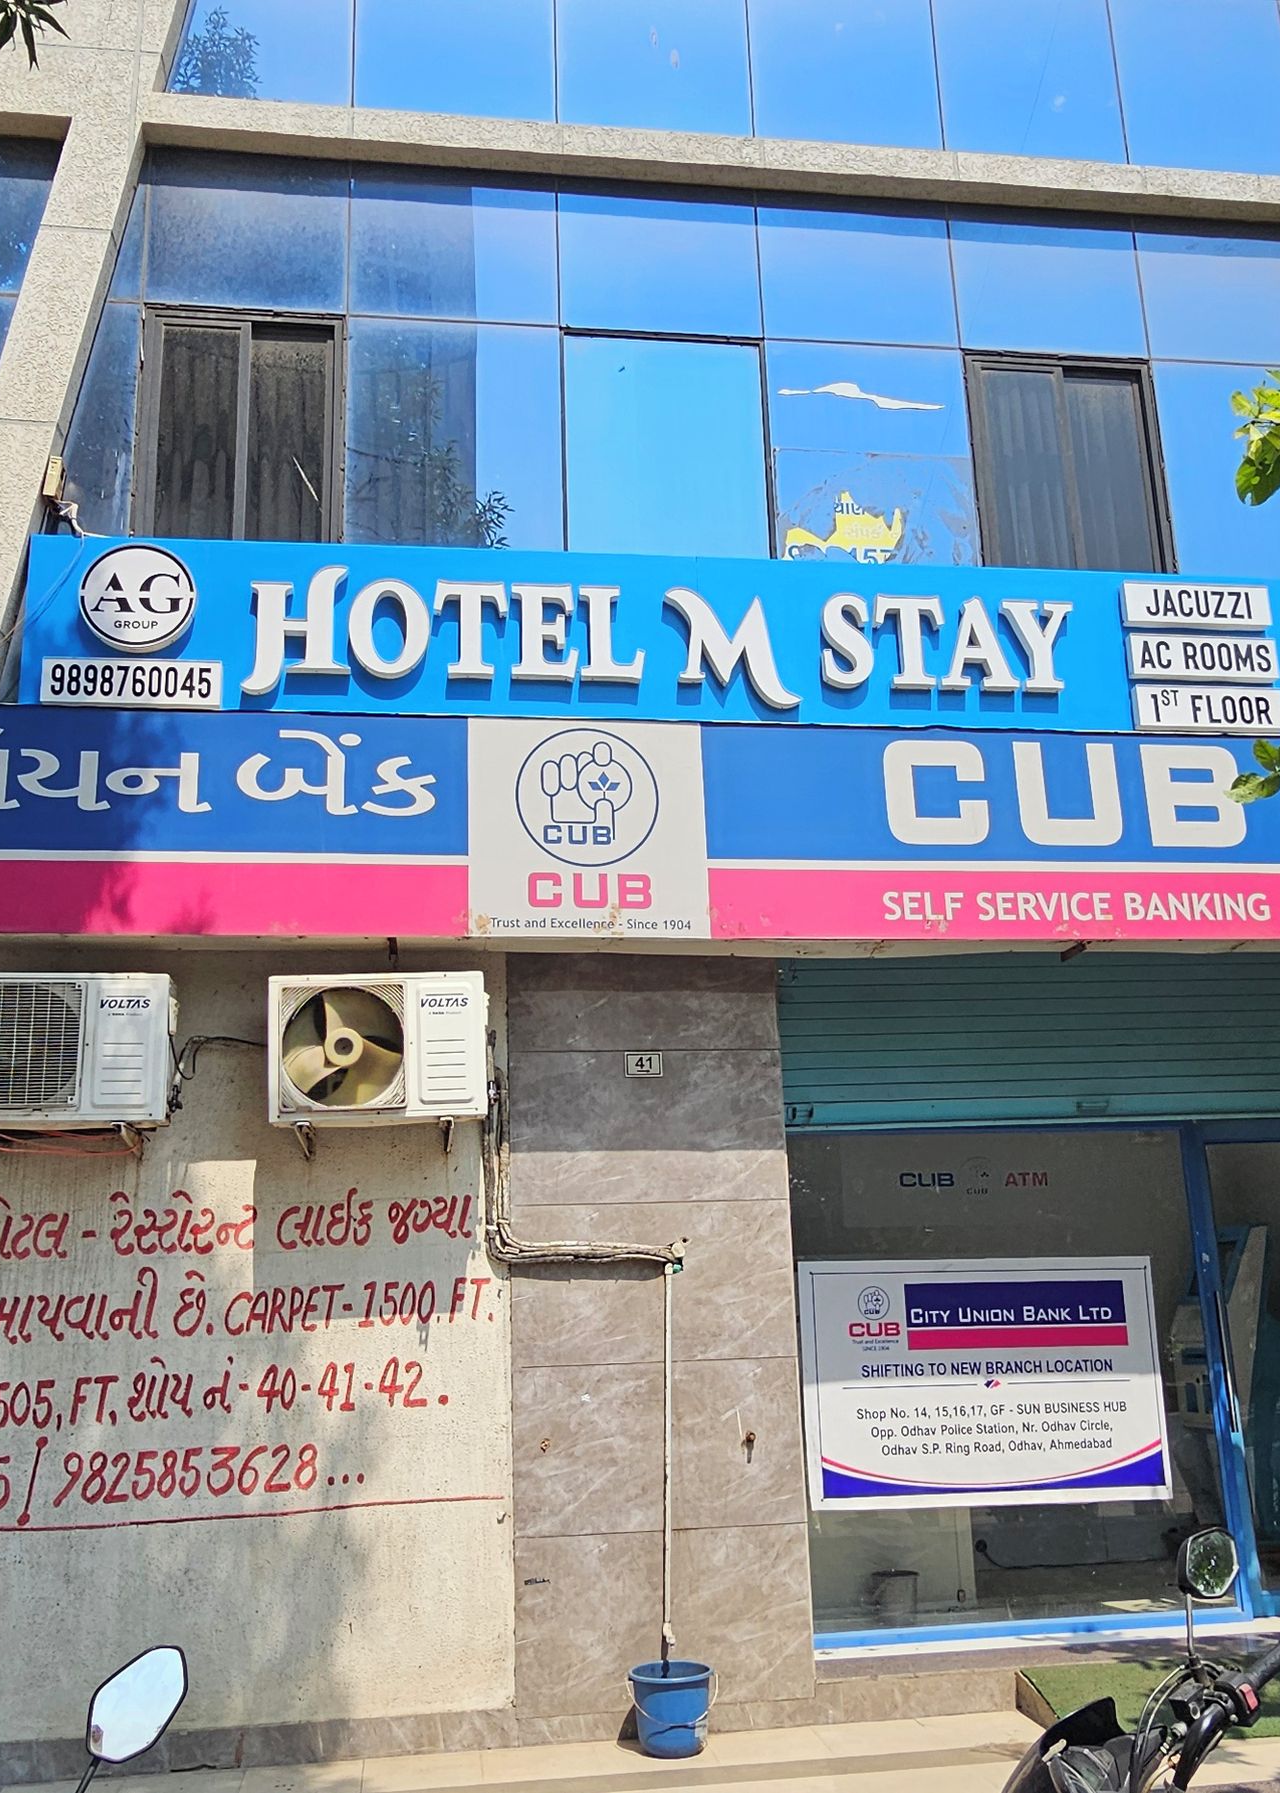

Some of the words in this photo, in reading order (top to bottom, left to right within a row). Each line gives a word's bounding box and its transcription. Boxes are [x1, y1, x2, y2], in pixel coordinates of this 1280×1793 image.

[90, 572, 184, 614] AG
[1145, 588, 1253, 620] JACUZZI
[114, 620, 158, 629] GROUP
[240, 565, 645, 696] HOTEL
[663, 586, 802, 711] M
[821, 592, 1073, 694] STAY
[1140, 640, 1172, 670] AC
[1181, 641, 1272, 673] ROOMS
[49, 663, 212, 699] 9898760045
[1150, 688, 1179, 723] 1ST
[1190, 694, 1273, 725] FLOOR
[236, 729, 436, 817] બેંક
[882, 740, 1248, 849] CUB
[543, 824, 612, 845] CUB
[527, 872, 652, 910] CUB
[882, 891, 965, 922] SELF
[976, 892, 1111, 923] SERVICE
[1124, 892, 1271, 923] BANKING
[490, 917, 521, 929] Trust
[524, 918, 547, 929] and
[550, 918, 615, 929] Excellence
[626, 918, 658, 930] Since
[663, 919, 692, 930] 1904
[100, 998, 151, 1009] VOLTAS
[420, 997, 469, 1008] VOLTAS
[634, 1056, 653, 1070] 41
[899, 1172, 955, 1188] CUB
[1005, 1171, 1048, 1187] ATM
[848, 1322, 901, 1337] CUB
[861, 1363, 925, 1378] SHIFTING
[928, 1362, 947, 1376] TO
[951, 1361, 982, 1376] NEW
[985, 1359, 1043, 1375] BRANCH
[1046, 1358, 1113, 1373] LOCATION
[856, 1407, 887, 1421] Shop
[890, 1407, 910, 1419] No.
[914, 1406, 931, 1419] 14,
[990, 1404, 1005, 1416] GF
[1016, 1403, 1041, 1415] SUN
[1044, 1401, 1100, 1414] BUSINESS
[1103, 1401, 1127, 1412] HUB
[870, 1426, 897, 1440] Opp.
[900, 1425, 937, 1437] Odhav
[940, 1424, 973, 1436] Police
[976, 1422, 1019, 1435] Station,
[1022, 1421, 1038, 1433] Nr.
[1041, 1420, 1077, 1432] Odhav
[1080, 1419, 1113, 1432] Circle,
[881, 1444, 918, 1456] Odhav
[921, 1442, 942, 1455] S.P.
[945, 1441, 970, 1456] Ring
[973, 1440, 1005, 1453] Road,
[1008, 1439, 1046, 1452] Odhav,
[1049, 1437, 1113, 1450] Ahmedabad
